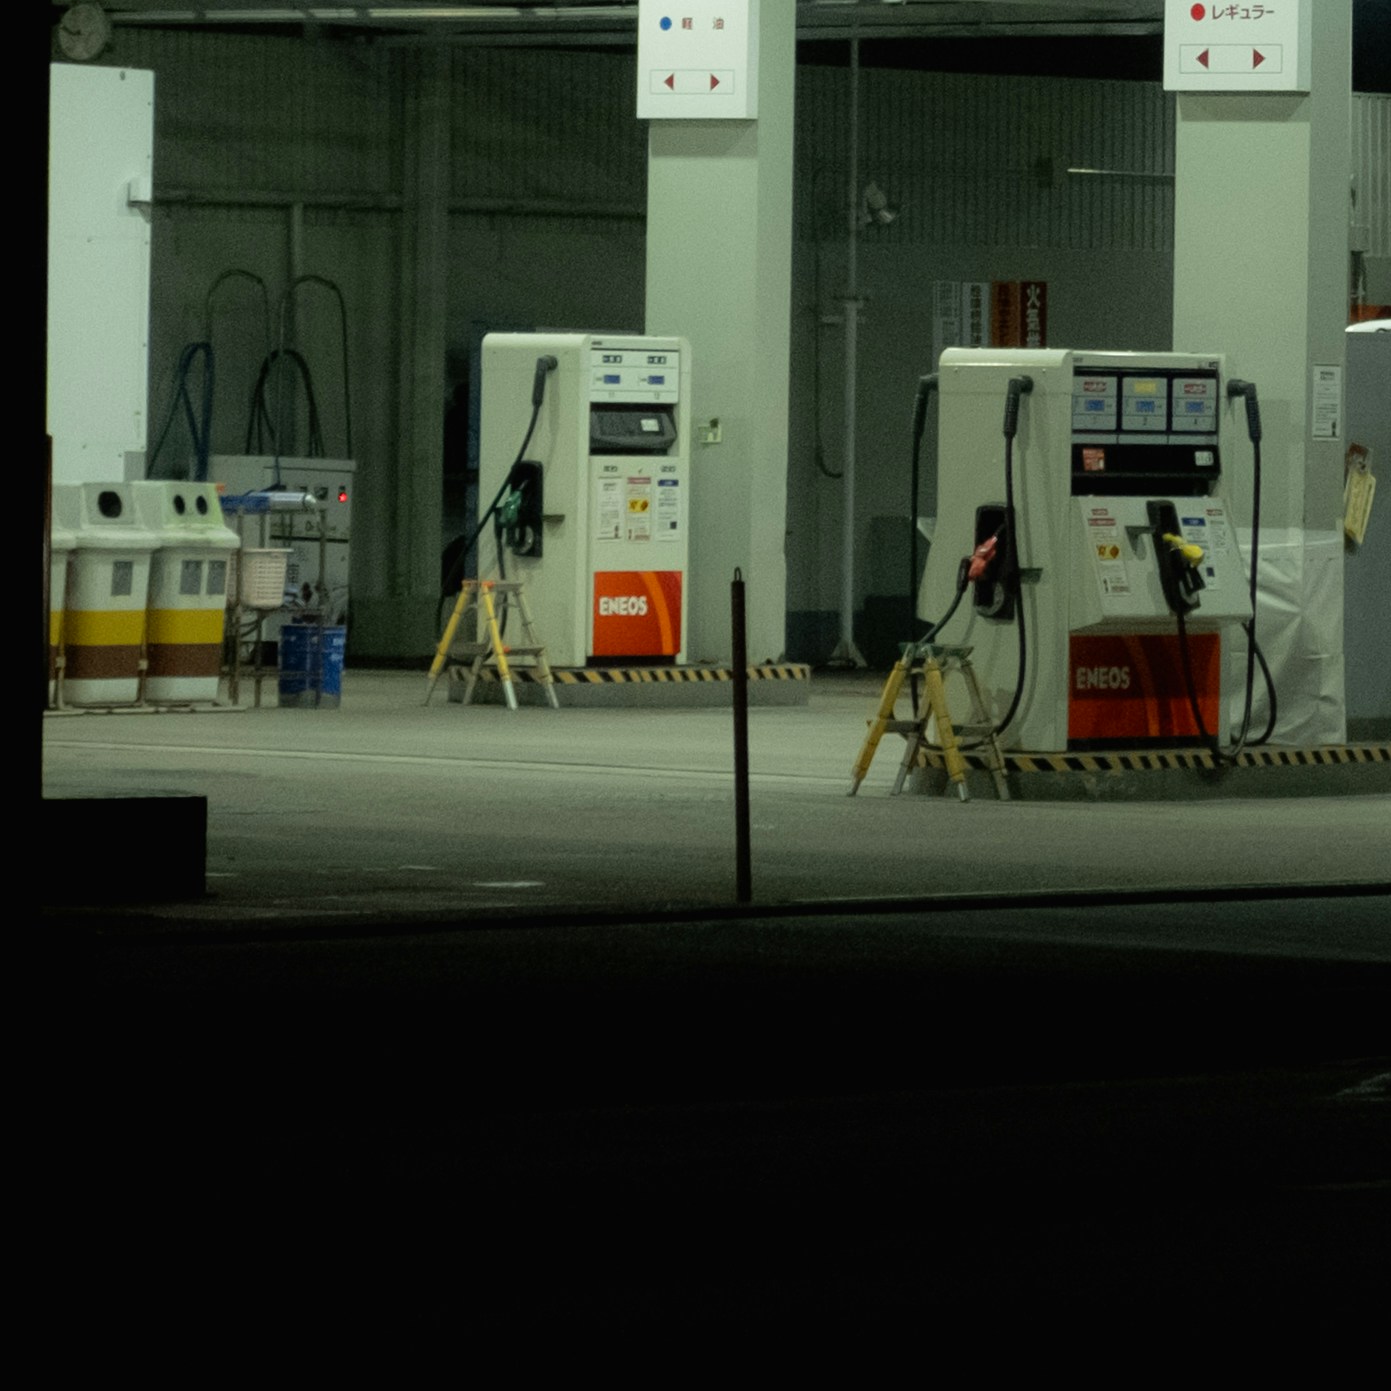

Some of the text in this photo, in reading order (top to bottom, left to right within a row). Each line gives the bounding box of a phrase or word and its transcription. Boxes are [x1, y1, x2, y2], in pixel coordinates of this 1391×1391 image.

[1211, 4, 1275, 20] レギュラー
[599, 595, 648, 616] ENEOS
[1075, 665, 1131, 690] ENEOS
